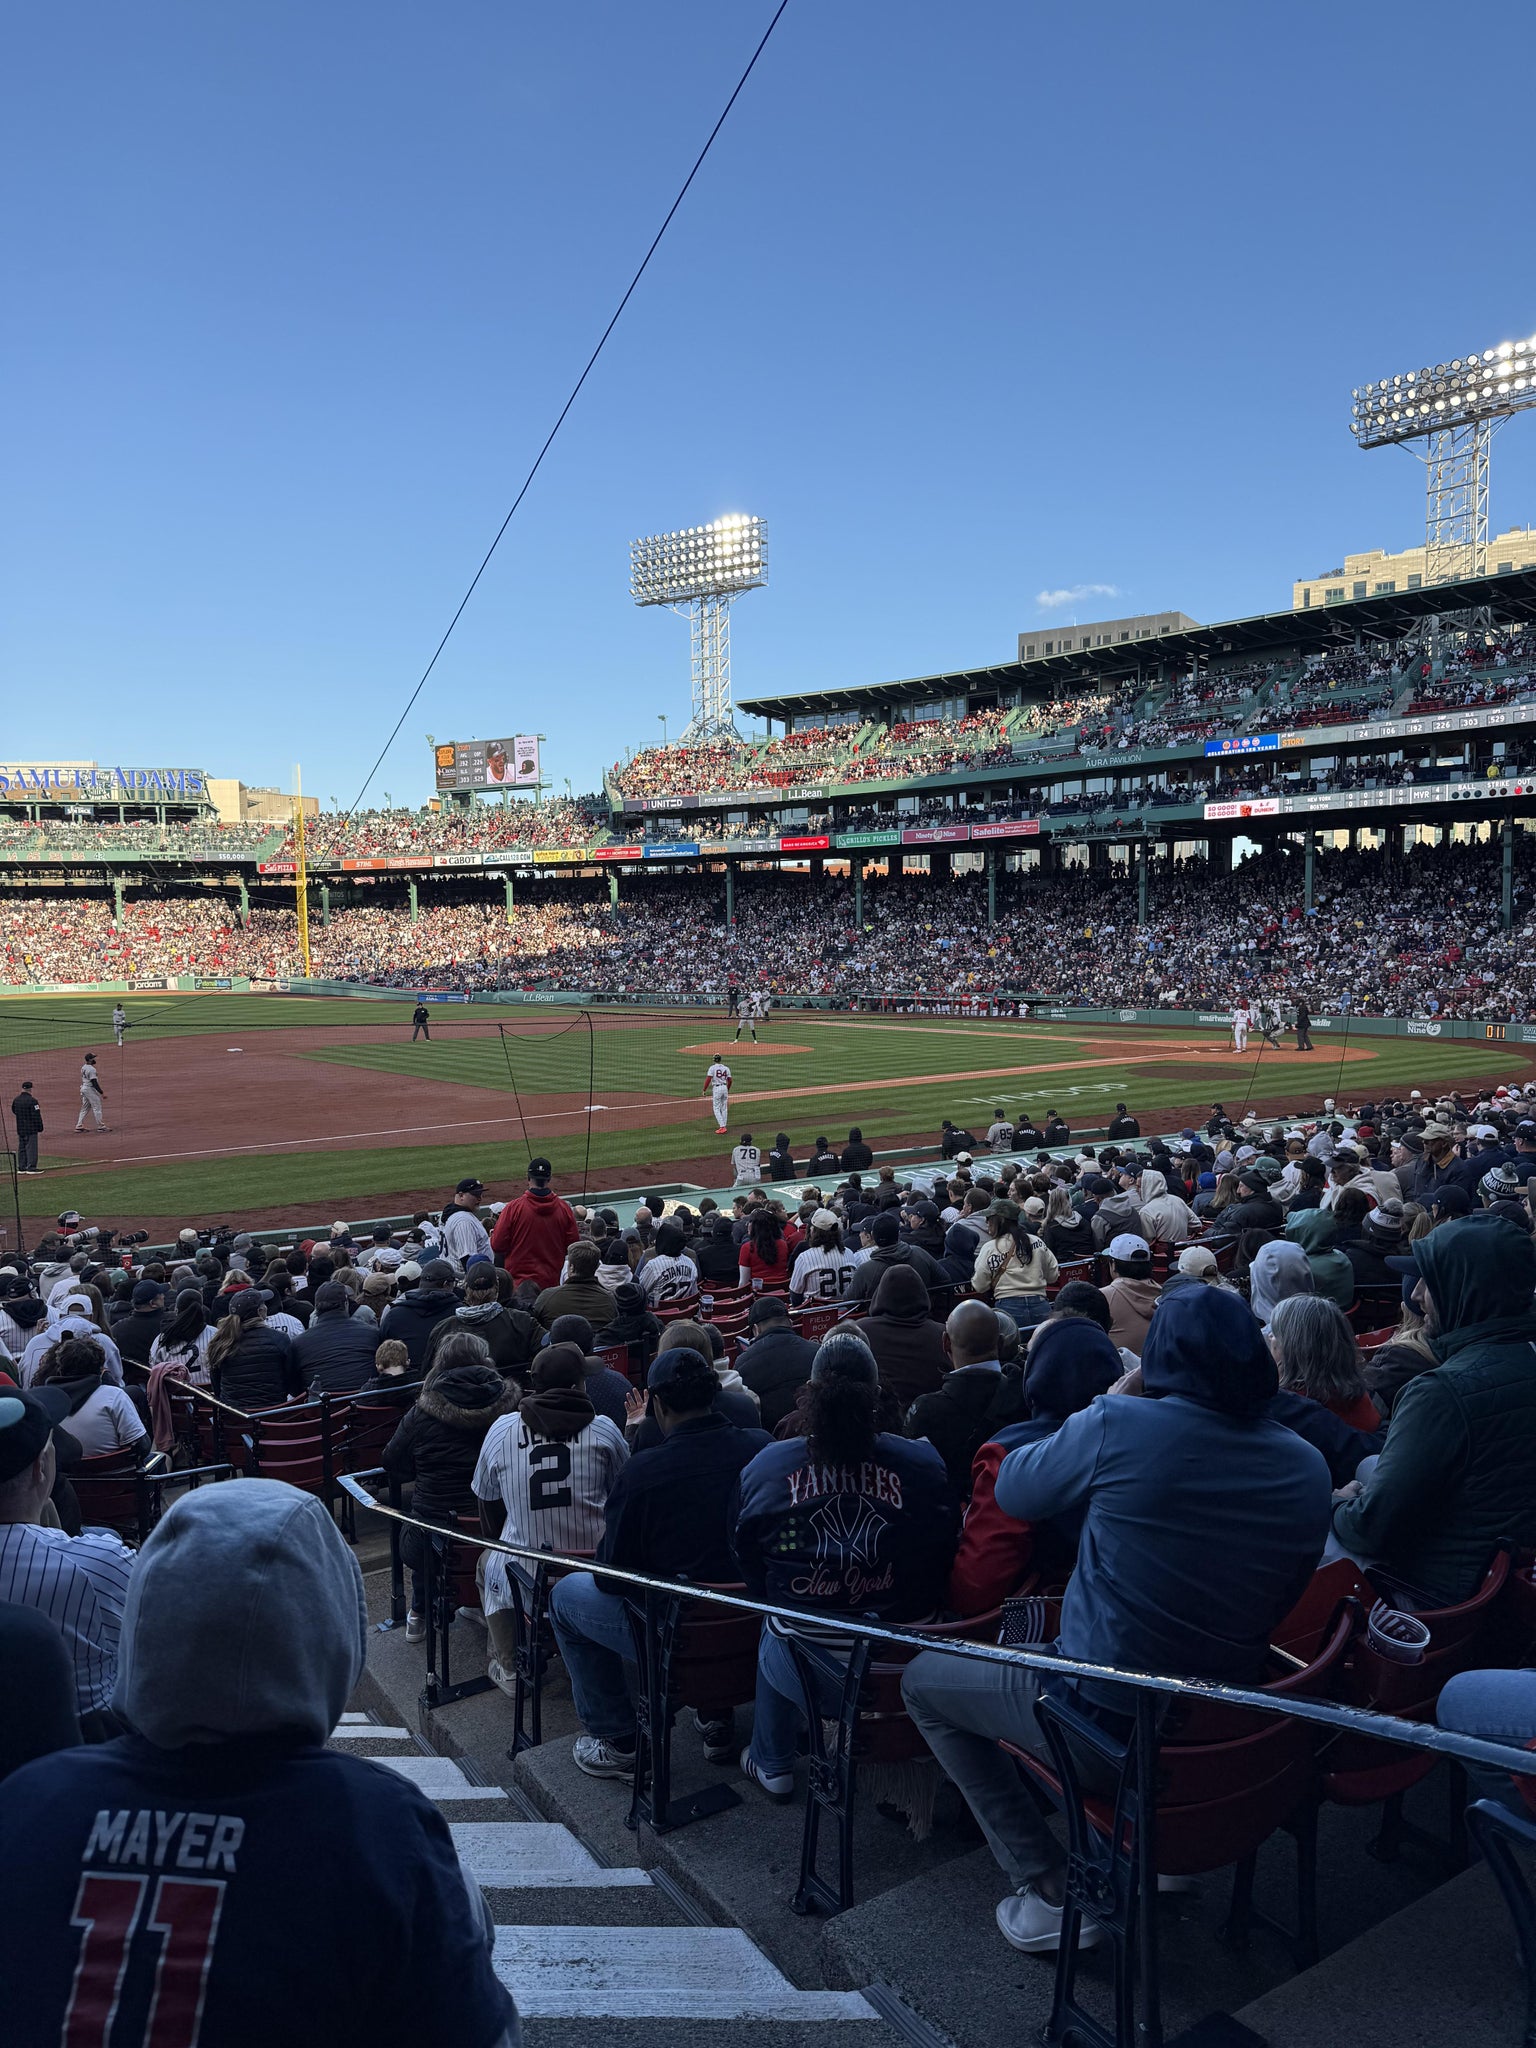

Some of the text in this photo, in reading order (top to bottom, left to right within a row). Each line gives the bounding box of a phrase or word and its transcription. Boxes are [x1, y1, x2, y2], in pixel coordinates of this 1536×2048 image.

[1461, 719, 1478, 727] .303
[1488, 715, 1505, 723] .529
[1434, 721, 1451, 729] .226
[1359, 730, 1368, 738] 24
[1382, 727, 1396, 735] 106
[1282, 737, 1305, 746] STORY
[1207, 748, 1245, 757] CELEBRATING
[1110, 754, 1141, 765] PAVILION
[0, 765, 100, 792] SAMUEL
[110, 766, 206, 792] ADAMS
[1457, 783, 1476, 791] BALL
[1487, 780, 1510, 788] STRIKE
[788, 789, 823, 800] L.L.Bean
[1413, 790, 1430, 799] MVR
[650, 799, 683, 809] UNITED
[916, 832, 933, 840] Ninety
[973, 826, 1005, 837] Safelite
[872, 834, 898, 842] PICKLES
[94, 852, 105, 860] 42
[278, 864, 294, 872] PIZZA
[523, 993, 555, 1002] L.L.Bean
[1407, 1026, 1427, 1034] Nine
[716, 1069, 728, 1079] 84
[952, 1082, 1129, 1105] WHOOP
[999, 1127, 1013, 1140] 85
[740, 1148, 757, 1160] 78
[809, 1315, 831, 1324] FIELD
[812, 1324, 828, 1332] BOX
[529, 1442, 572, 1511] 2
[786, 1461, 903, 1510] YANKEES
[81, 1808, 246, 1874] MAYER
[61, 1871, 227, 2048] 11
